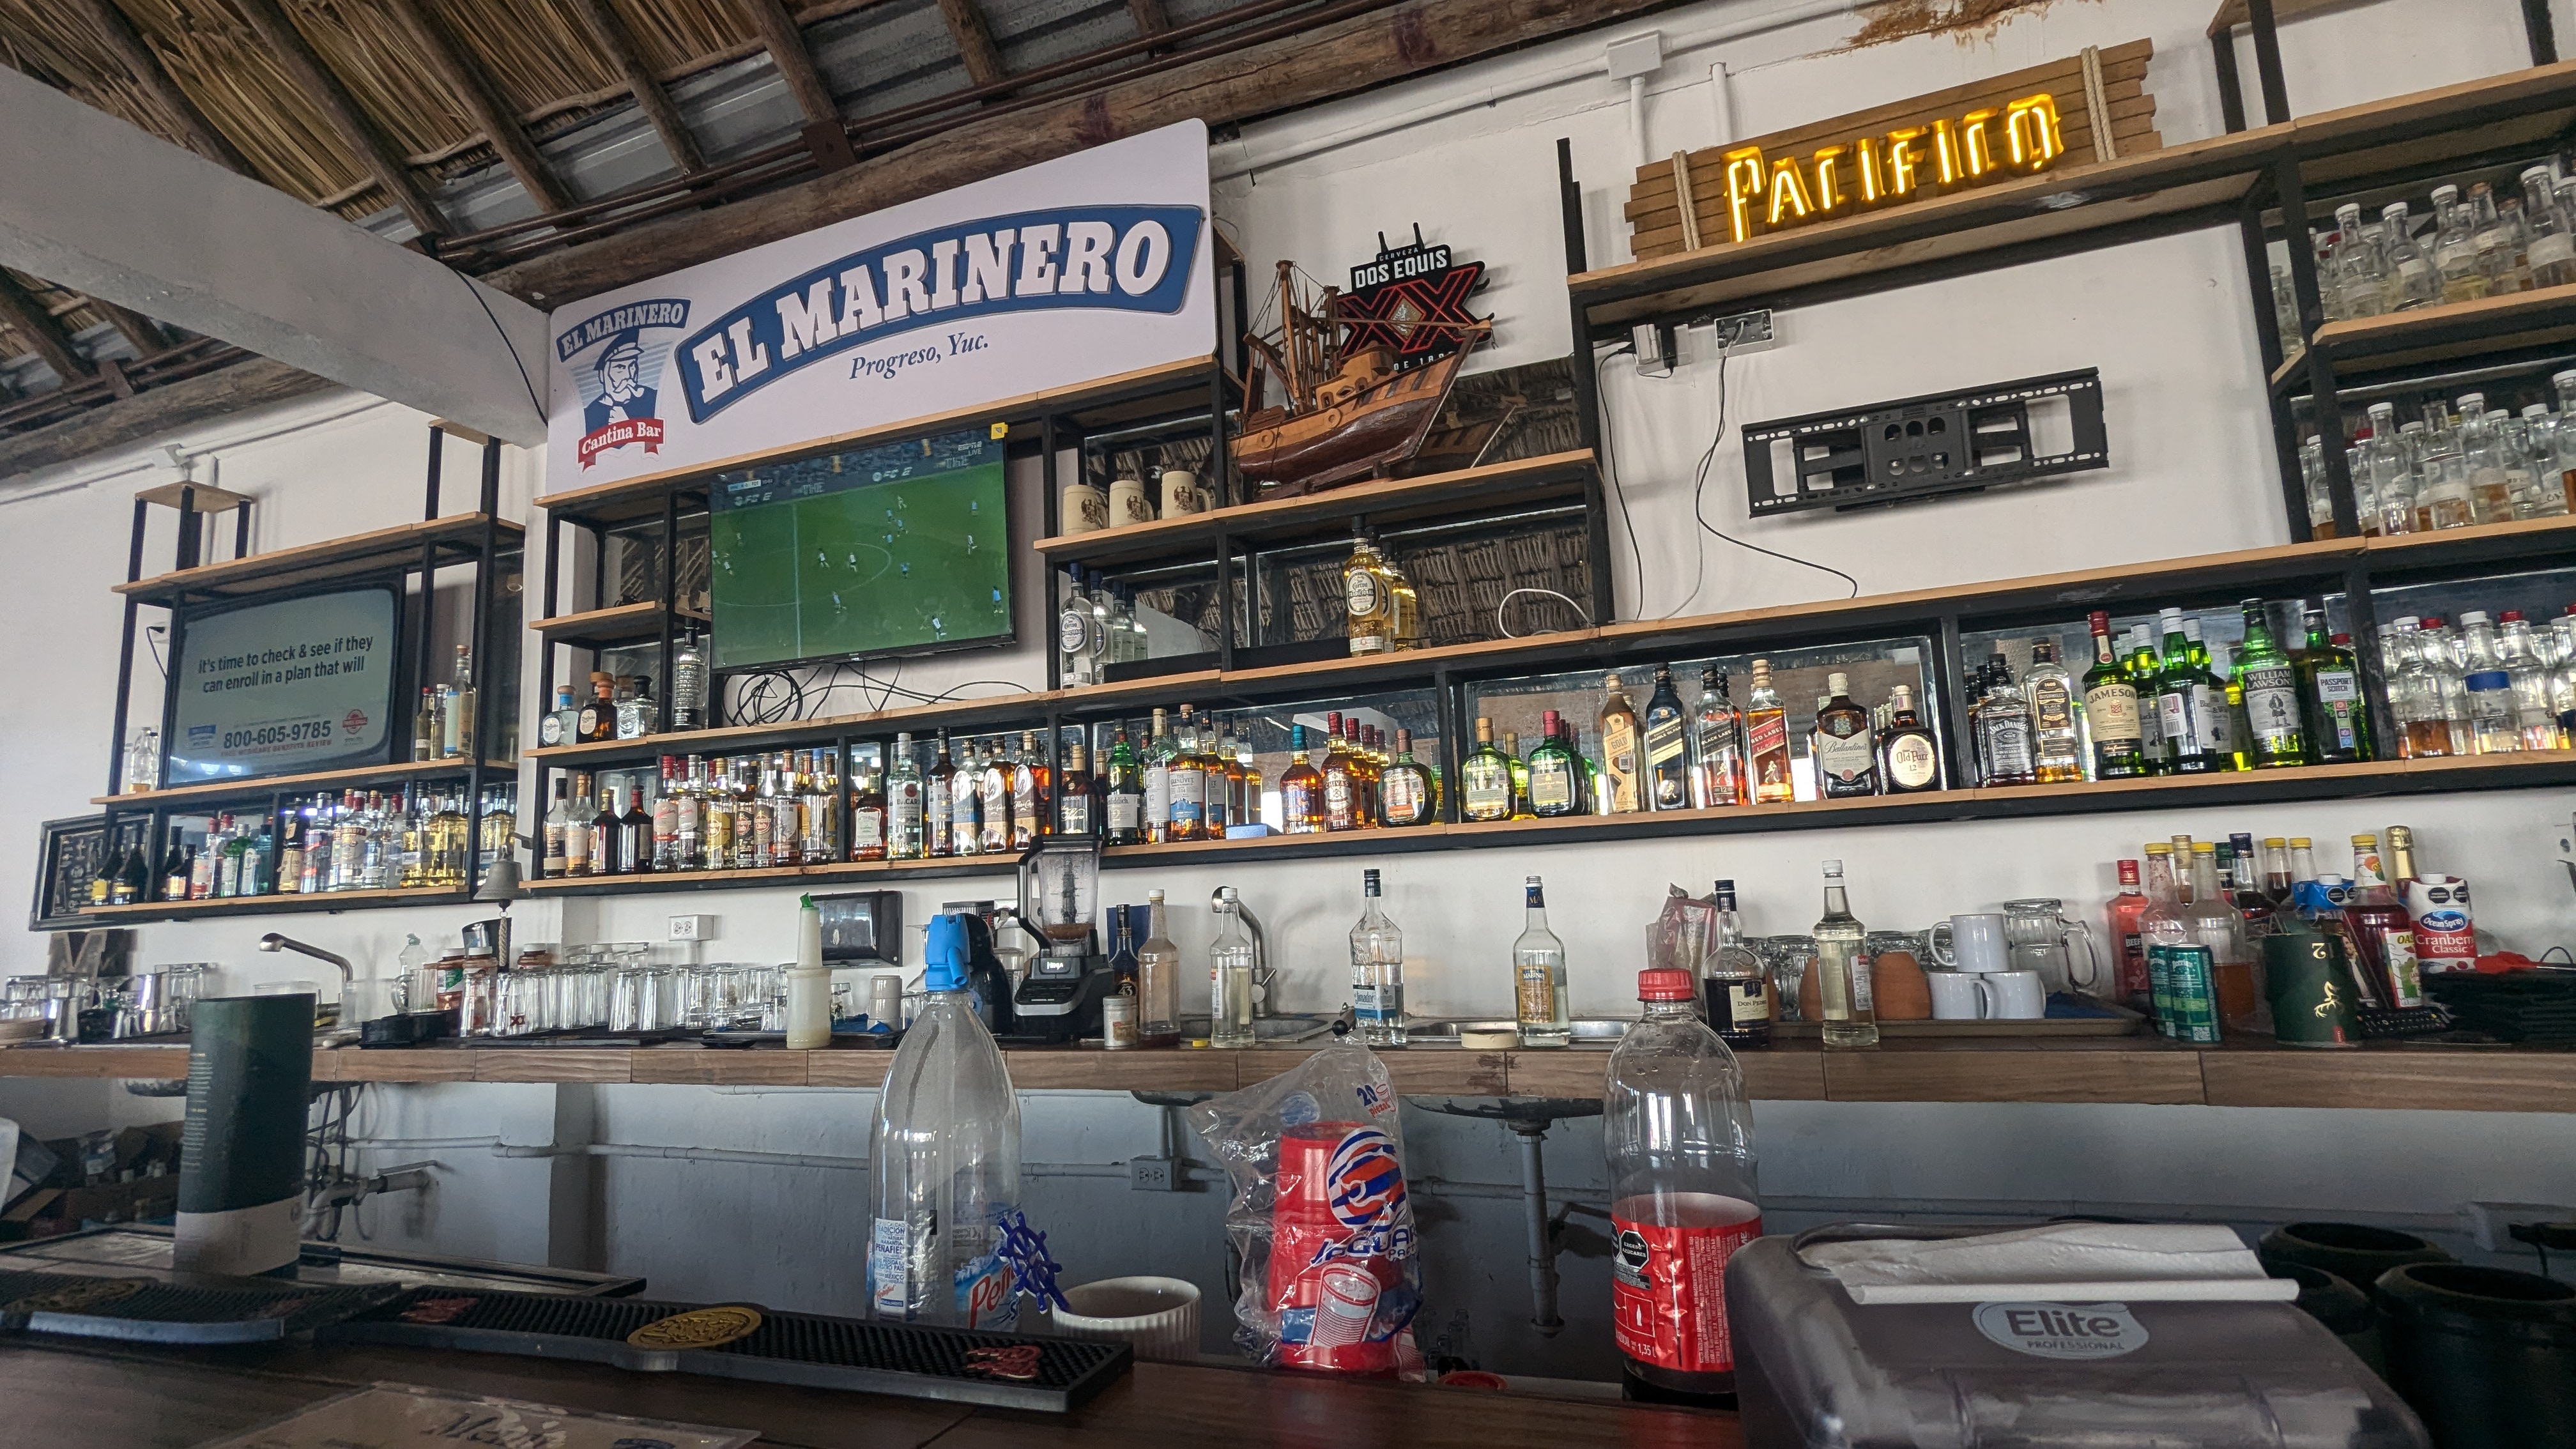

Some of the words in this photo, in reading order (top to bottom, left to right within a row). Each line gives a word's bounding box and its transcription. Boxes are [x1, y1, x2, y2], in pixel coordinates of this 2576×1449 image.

[1379, 247, 1418, 261] CERVEZA
[1355, 264, 1390, 288] DOS
[1394, 249, 1447, 279] EQUIS
[692, 316, 770, 404] EL
[776, 220, 1170, 360] MARINERO
[562, 330, 584, 356] EL
[585, 303, 684, 342] MARINERO
[849, 347, 941, 379] Progreso,
[947, 332, 988, 356] Yuc.
[581, 425, 633, 454] Cantina
[637, 422, 661, 437] Bar
[218, 656, 243, 671] time
[247, 653, 258, 666] to
[262, 645, 296, 664] check
[298, 644, 307, 658] &
[310, 643, 331, 657] see
[335, 638, 343, 653] if
[346, 636, 373, 652] they
[203, 680, 223, 693] can
[226, 671, 259, 690] enroll
[262, 669, 272, 685] in
[275, 671, 282, 682] a
[286, 666, 311, 684] plan
[315, 660, 339, 677] that
[343, 656, 365, 673] will
[2248, 670, 2290, 681] WILLIAM
[2320, 677, 2352, 686] PASSPORT
[2090, 688, 2136, 704] JAMESON
[224, 720, 331, 749] 800-605-9785
[1650, 733, 1666, 743] DOUBLE
[1667, 726, 1682, 735] BLACK
[1701, 735, 1718, 745] BLACK
[1718, 729, 1734, 739] LABEL
[1751, 735, 1763, 744] RED
[1764, 726, 1783, 738] LABEL
[1989, 723, 2005, 735] JACK
[307, 739, 332, 748] REVIEW
[1611, 737, 1628, 749] GOLD
[1825, 741, 1867, 754] Ballantine's
[1897, 751, 1910, 763] Old
[1910, 750, 1929, 763] Parr
[2423, 917, 2444, 927] Ocean
[2444, 917, 2464, 928] Spray
[2432, 945, 2468, 953] Classic
[1118, 985, 1133, 996] 43
[1356, 1085, 1378, 1107] 20
[2005, 1310, 2120, 1337] Elite
[1637, 1342, 1651, 1356] 1,35
[2027, 1340, 2124, 1350] PROFESSIONAL
